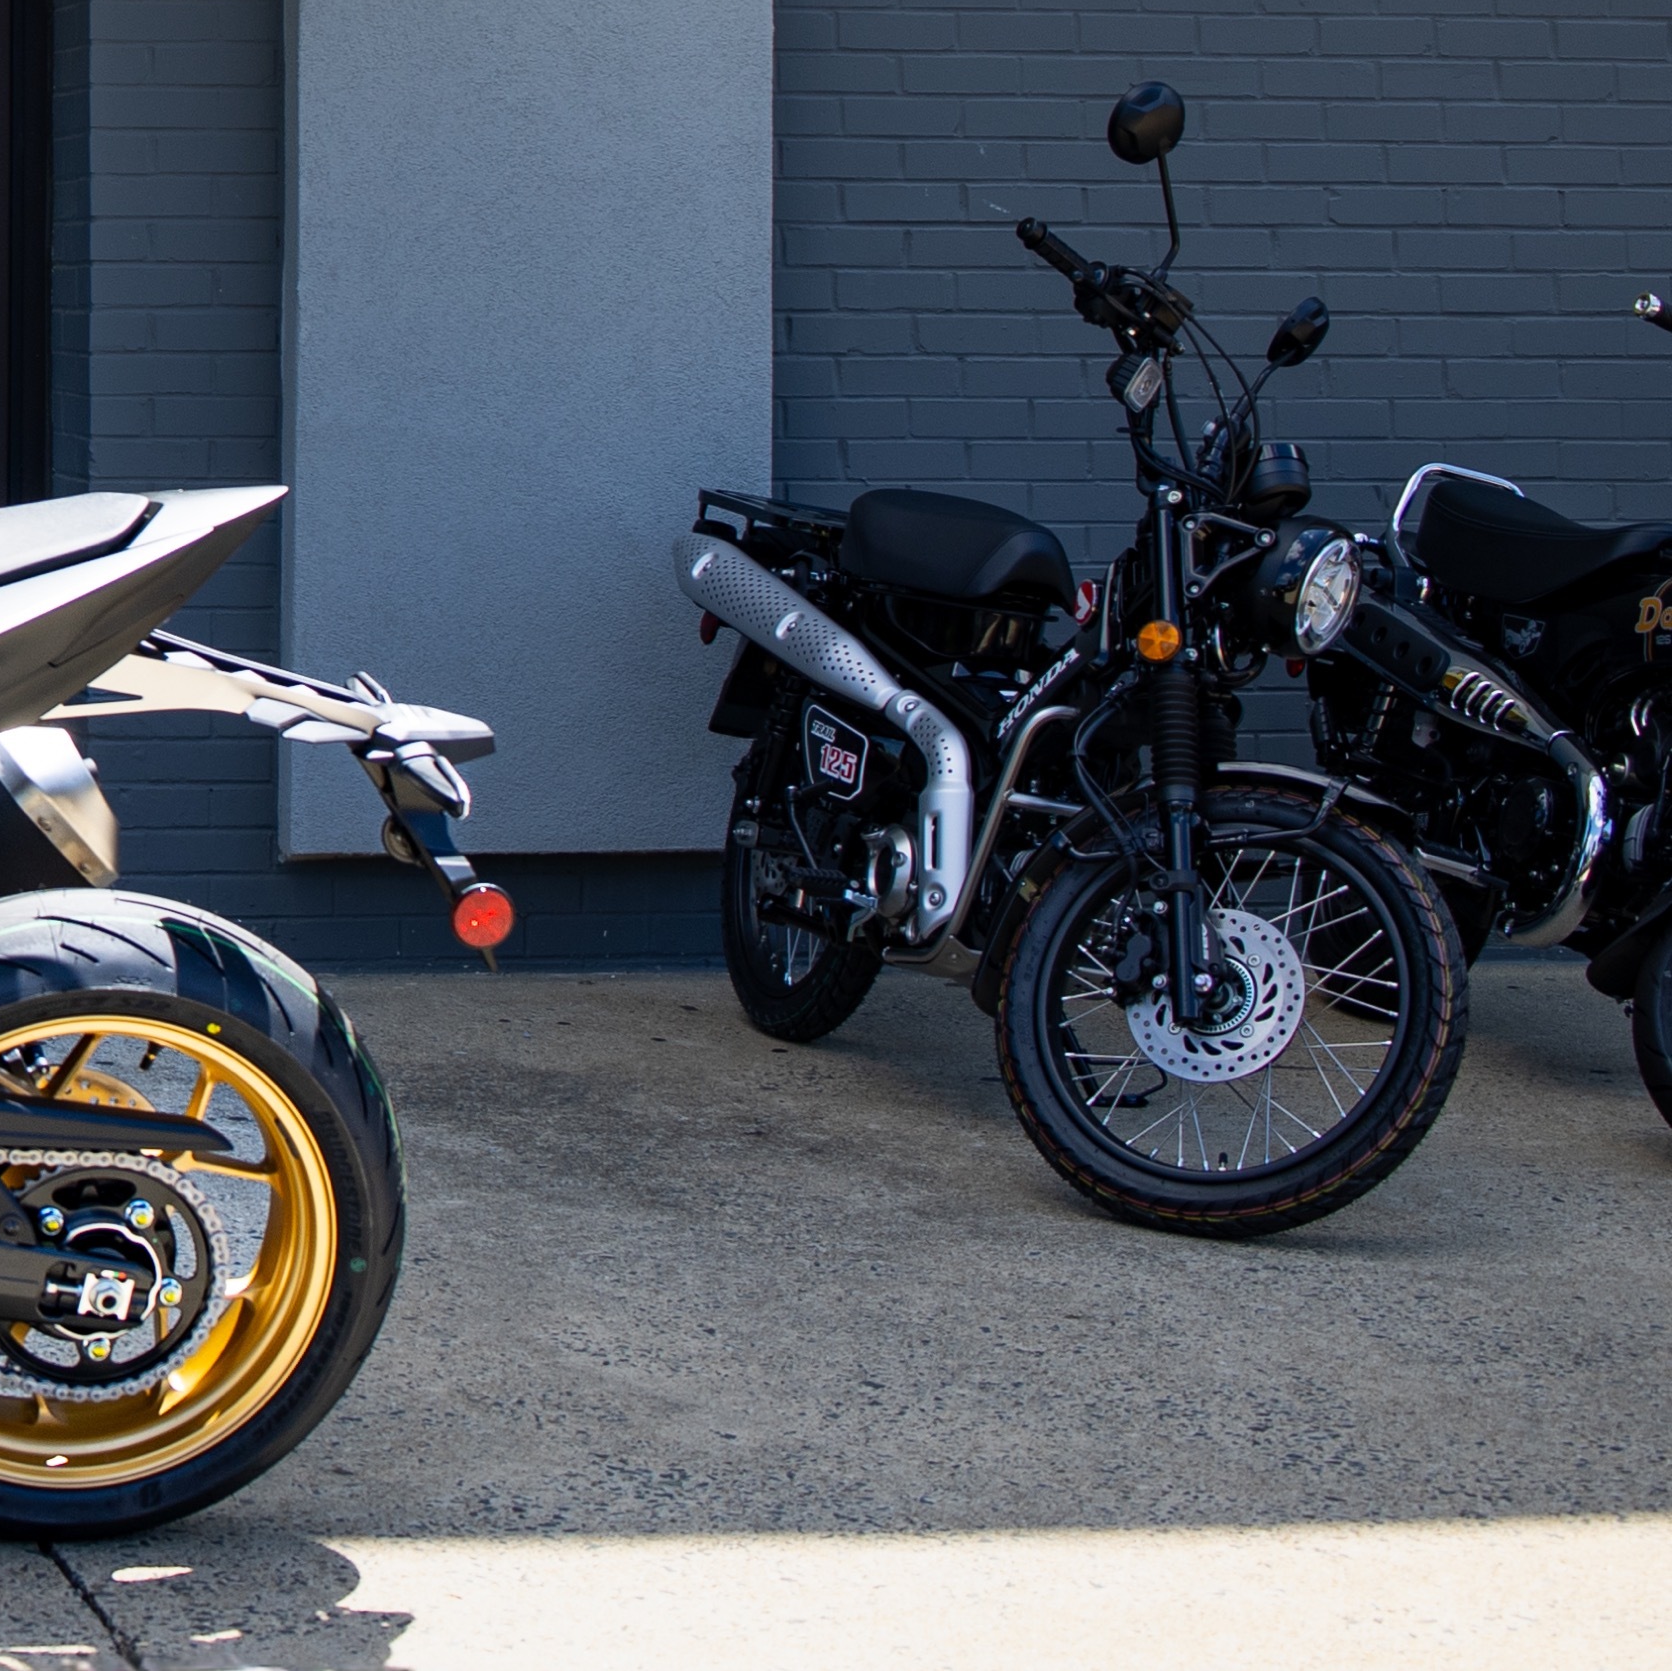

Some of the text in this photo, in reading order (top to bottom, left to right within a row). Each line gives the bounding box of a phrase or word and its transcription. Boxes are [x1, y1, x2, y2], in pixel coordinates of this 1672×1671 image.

[996, 647, 1080, 739] HONDA
[811, 719, 837, 744] TRAIL
[819, 743, 859, 785] 125
[316, 1110, 362, 1254] BRIDGESTONE
